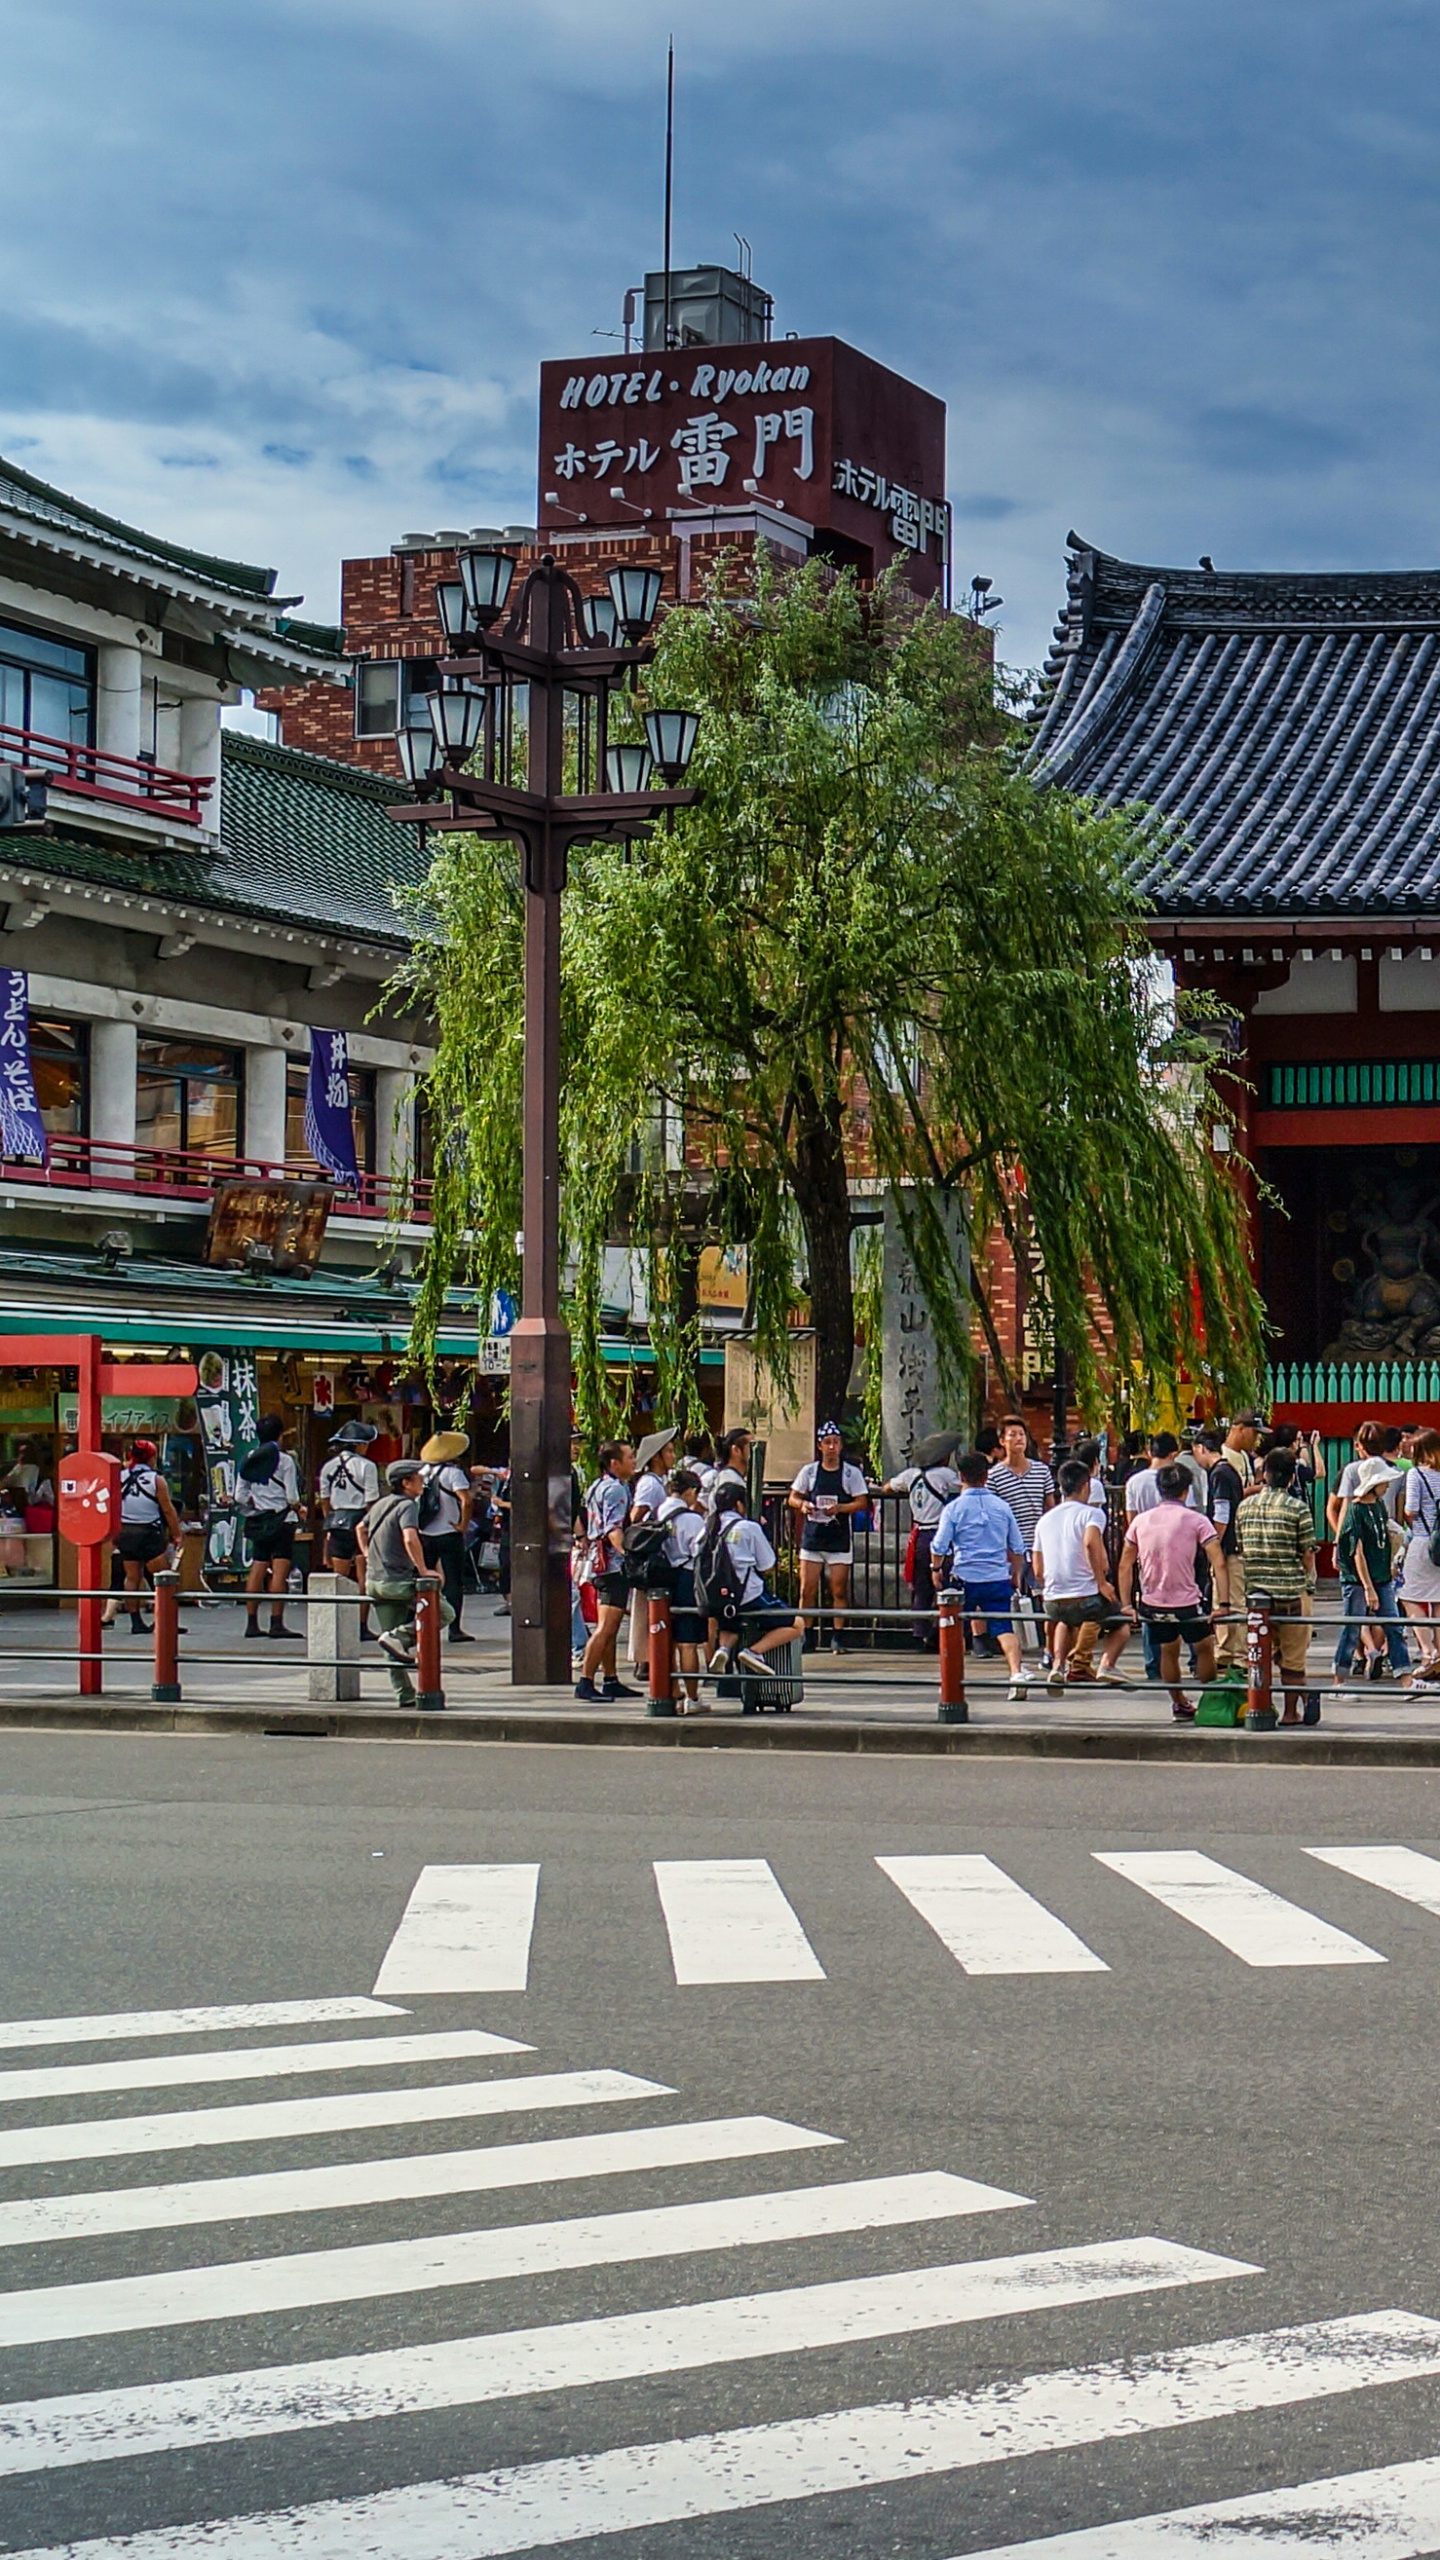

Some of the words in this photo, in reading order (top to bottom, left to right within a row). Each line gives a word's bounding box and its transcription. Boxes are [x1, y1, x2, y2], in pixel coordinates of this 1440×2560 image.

[559, 370, 662, 409] HOTEL
[690, 361, 810, 404] Ryokan
[832, 459, 949, 564] ホテル雷門
[325, 1033, 349, 1108] 丼物
